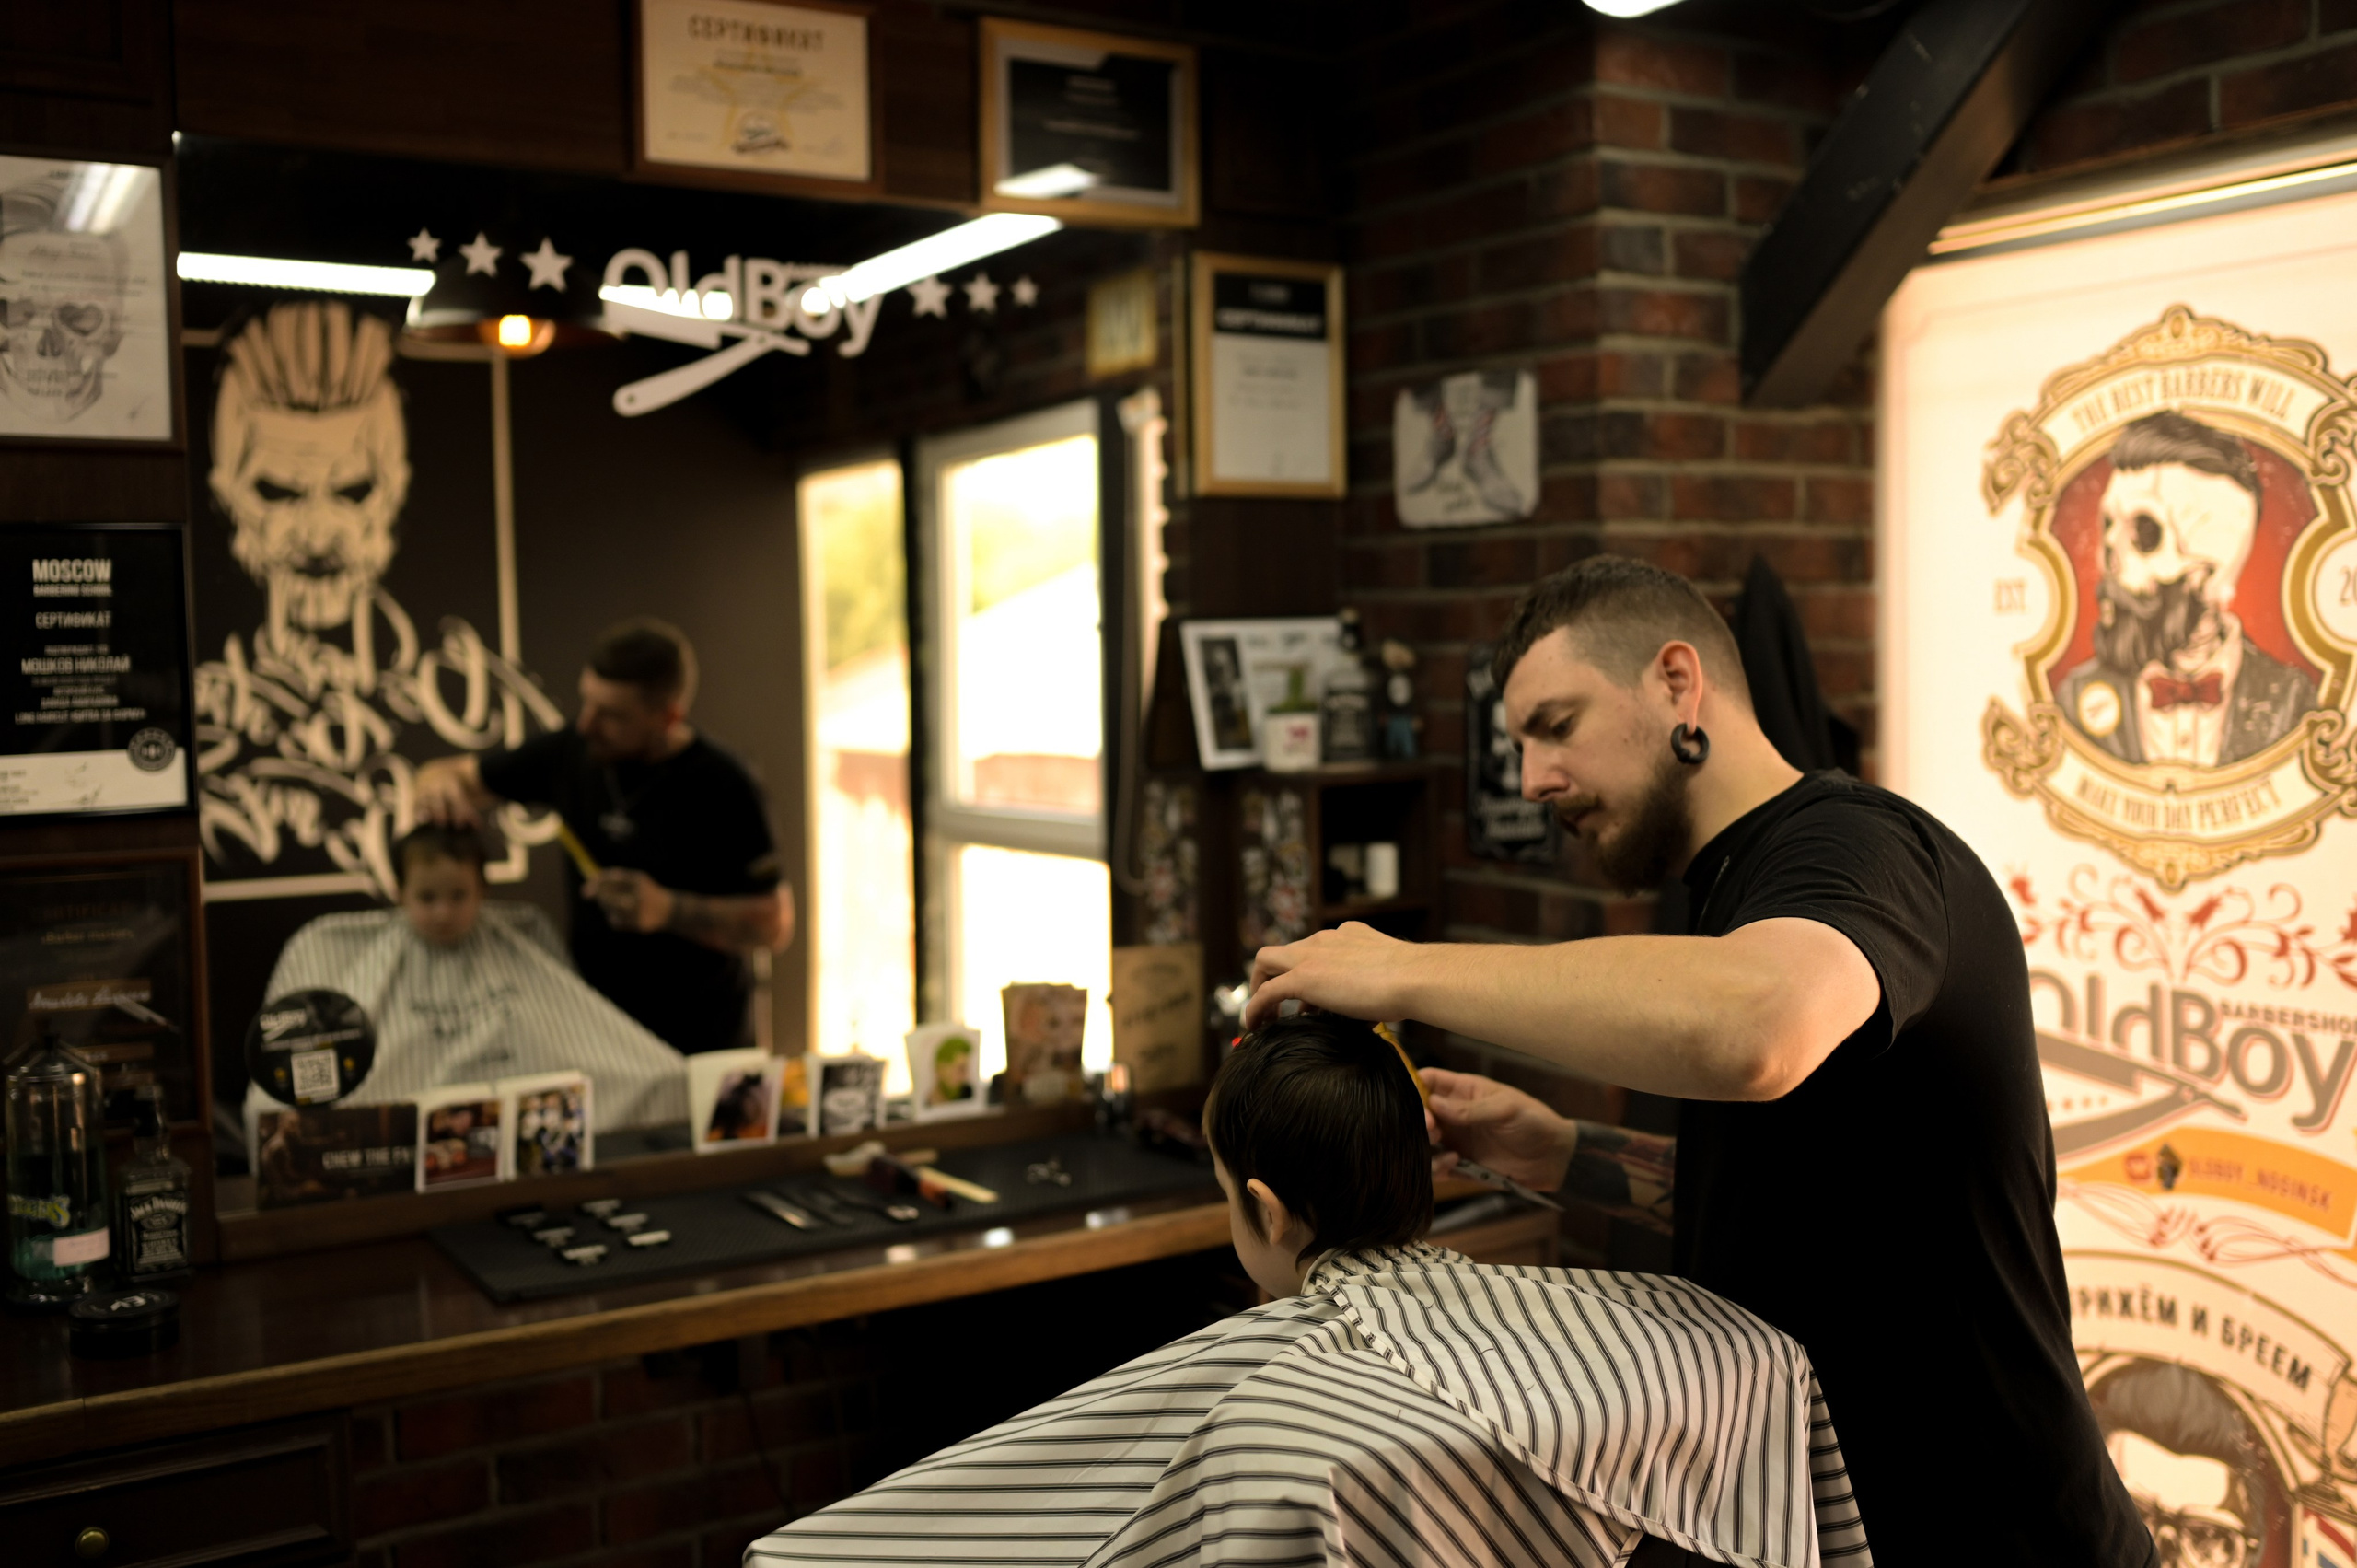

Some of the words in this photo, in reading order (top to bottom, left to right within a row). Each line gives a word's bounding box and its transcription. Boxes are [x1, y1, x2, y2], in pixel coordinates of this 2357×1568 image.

[32, 558, 112, 582] MOSCOW
[35, 610, 112, 630] СЕРТИФИКАТ
[2220, 998, 2357, 1036] BARBERSHO
[2072, 1283, 2178, 1327] РИЖЁМ
[2192, 1302, 2209, 1338] И
[2222, 1316, 2312, 1392] БРЕЕМ
